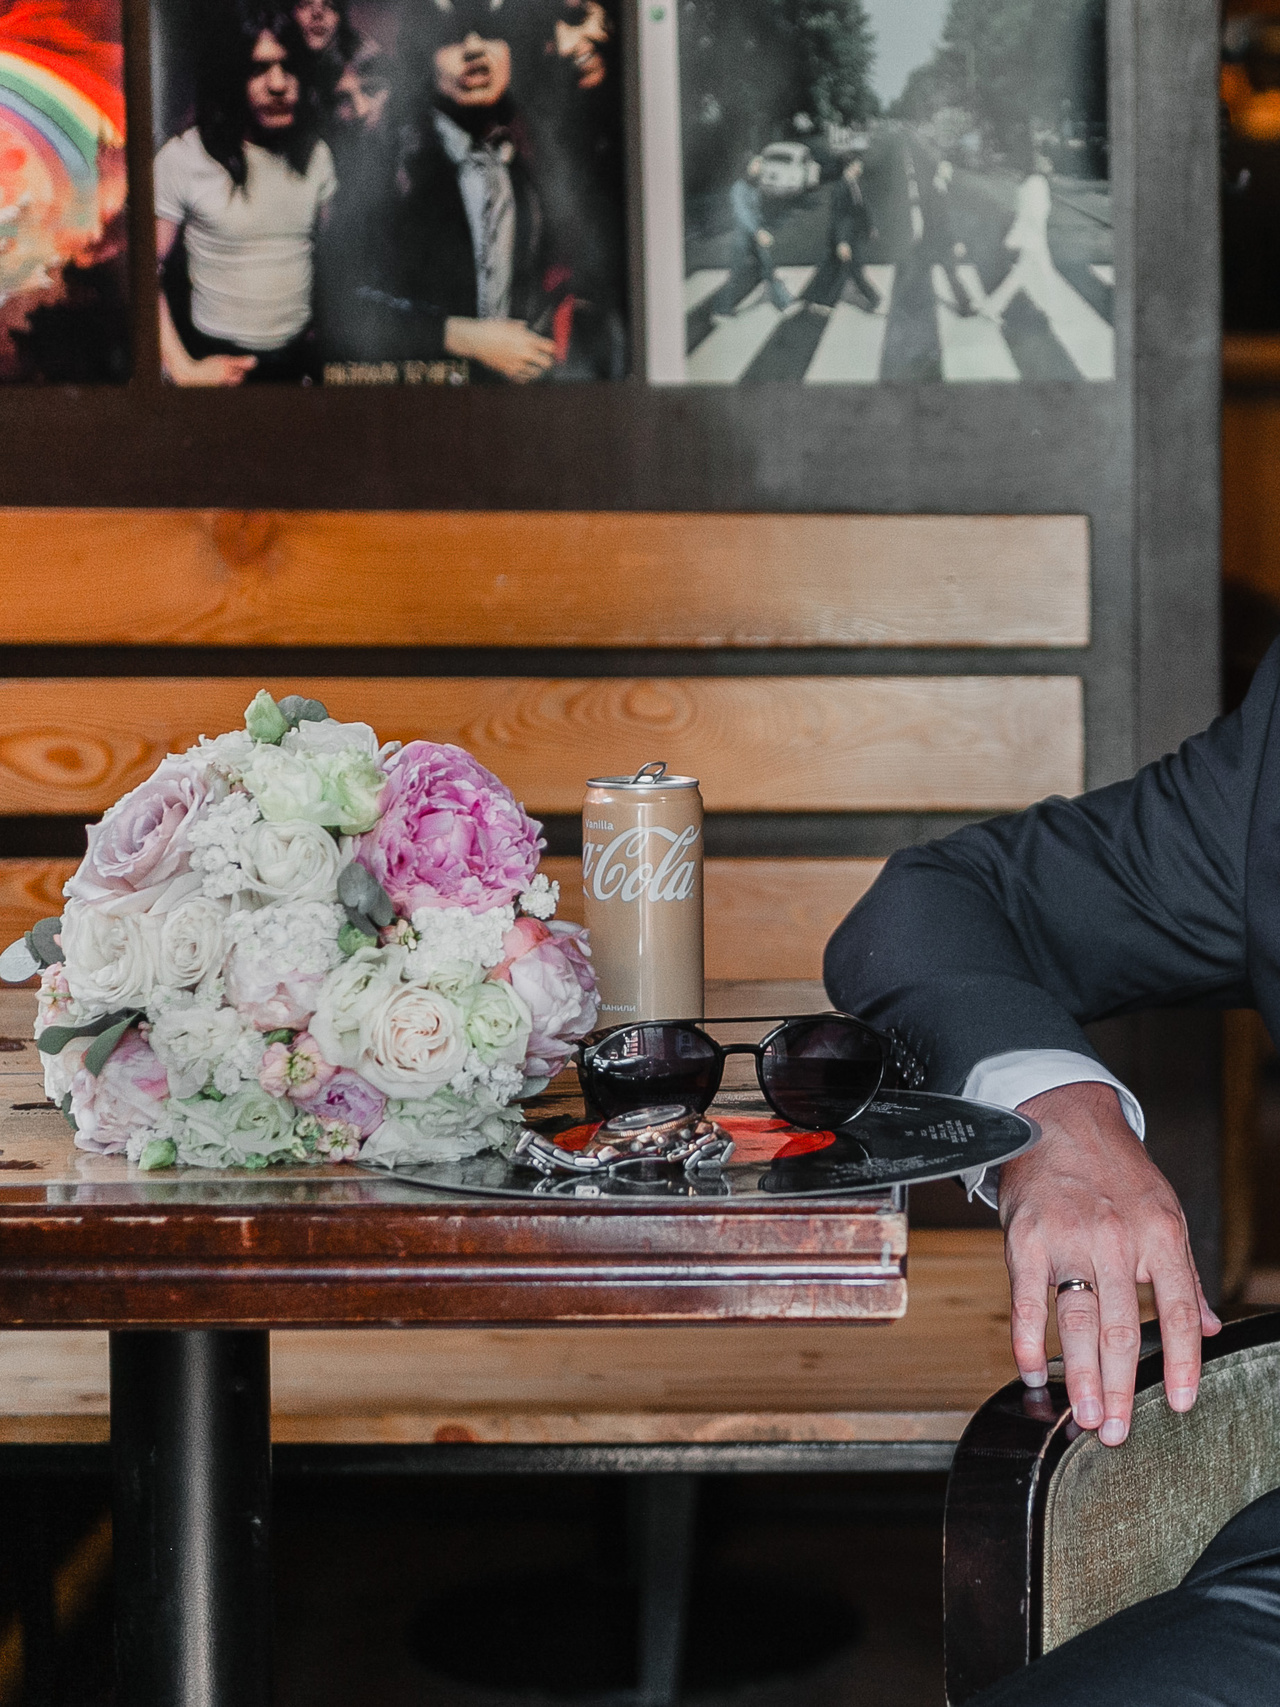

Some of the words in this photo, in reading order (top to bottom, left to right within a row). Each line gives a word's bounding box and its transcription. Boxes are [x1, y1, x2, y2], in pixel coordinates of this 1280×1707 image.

[585, 818, 614, 832] Vanilla
[582, 824, 700, 903] a-Cola
[601, 1003, 637, 1013] ВАНИЛИ
